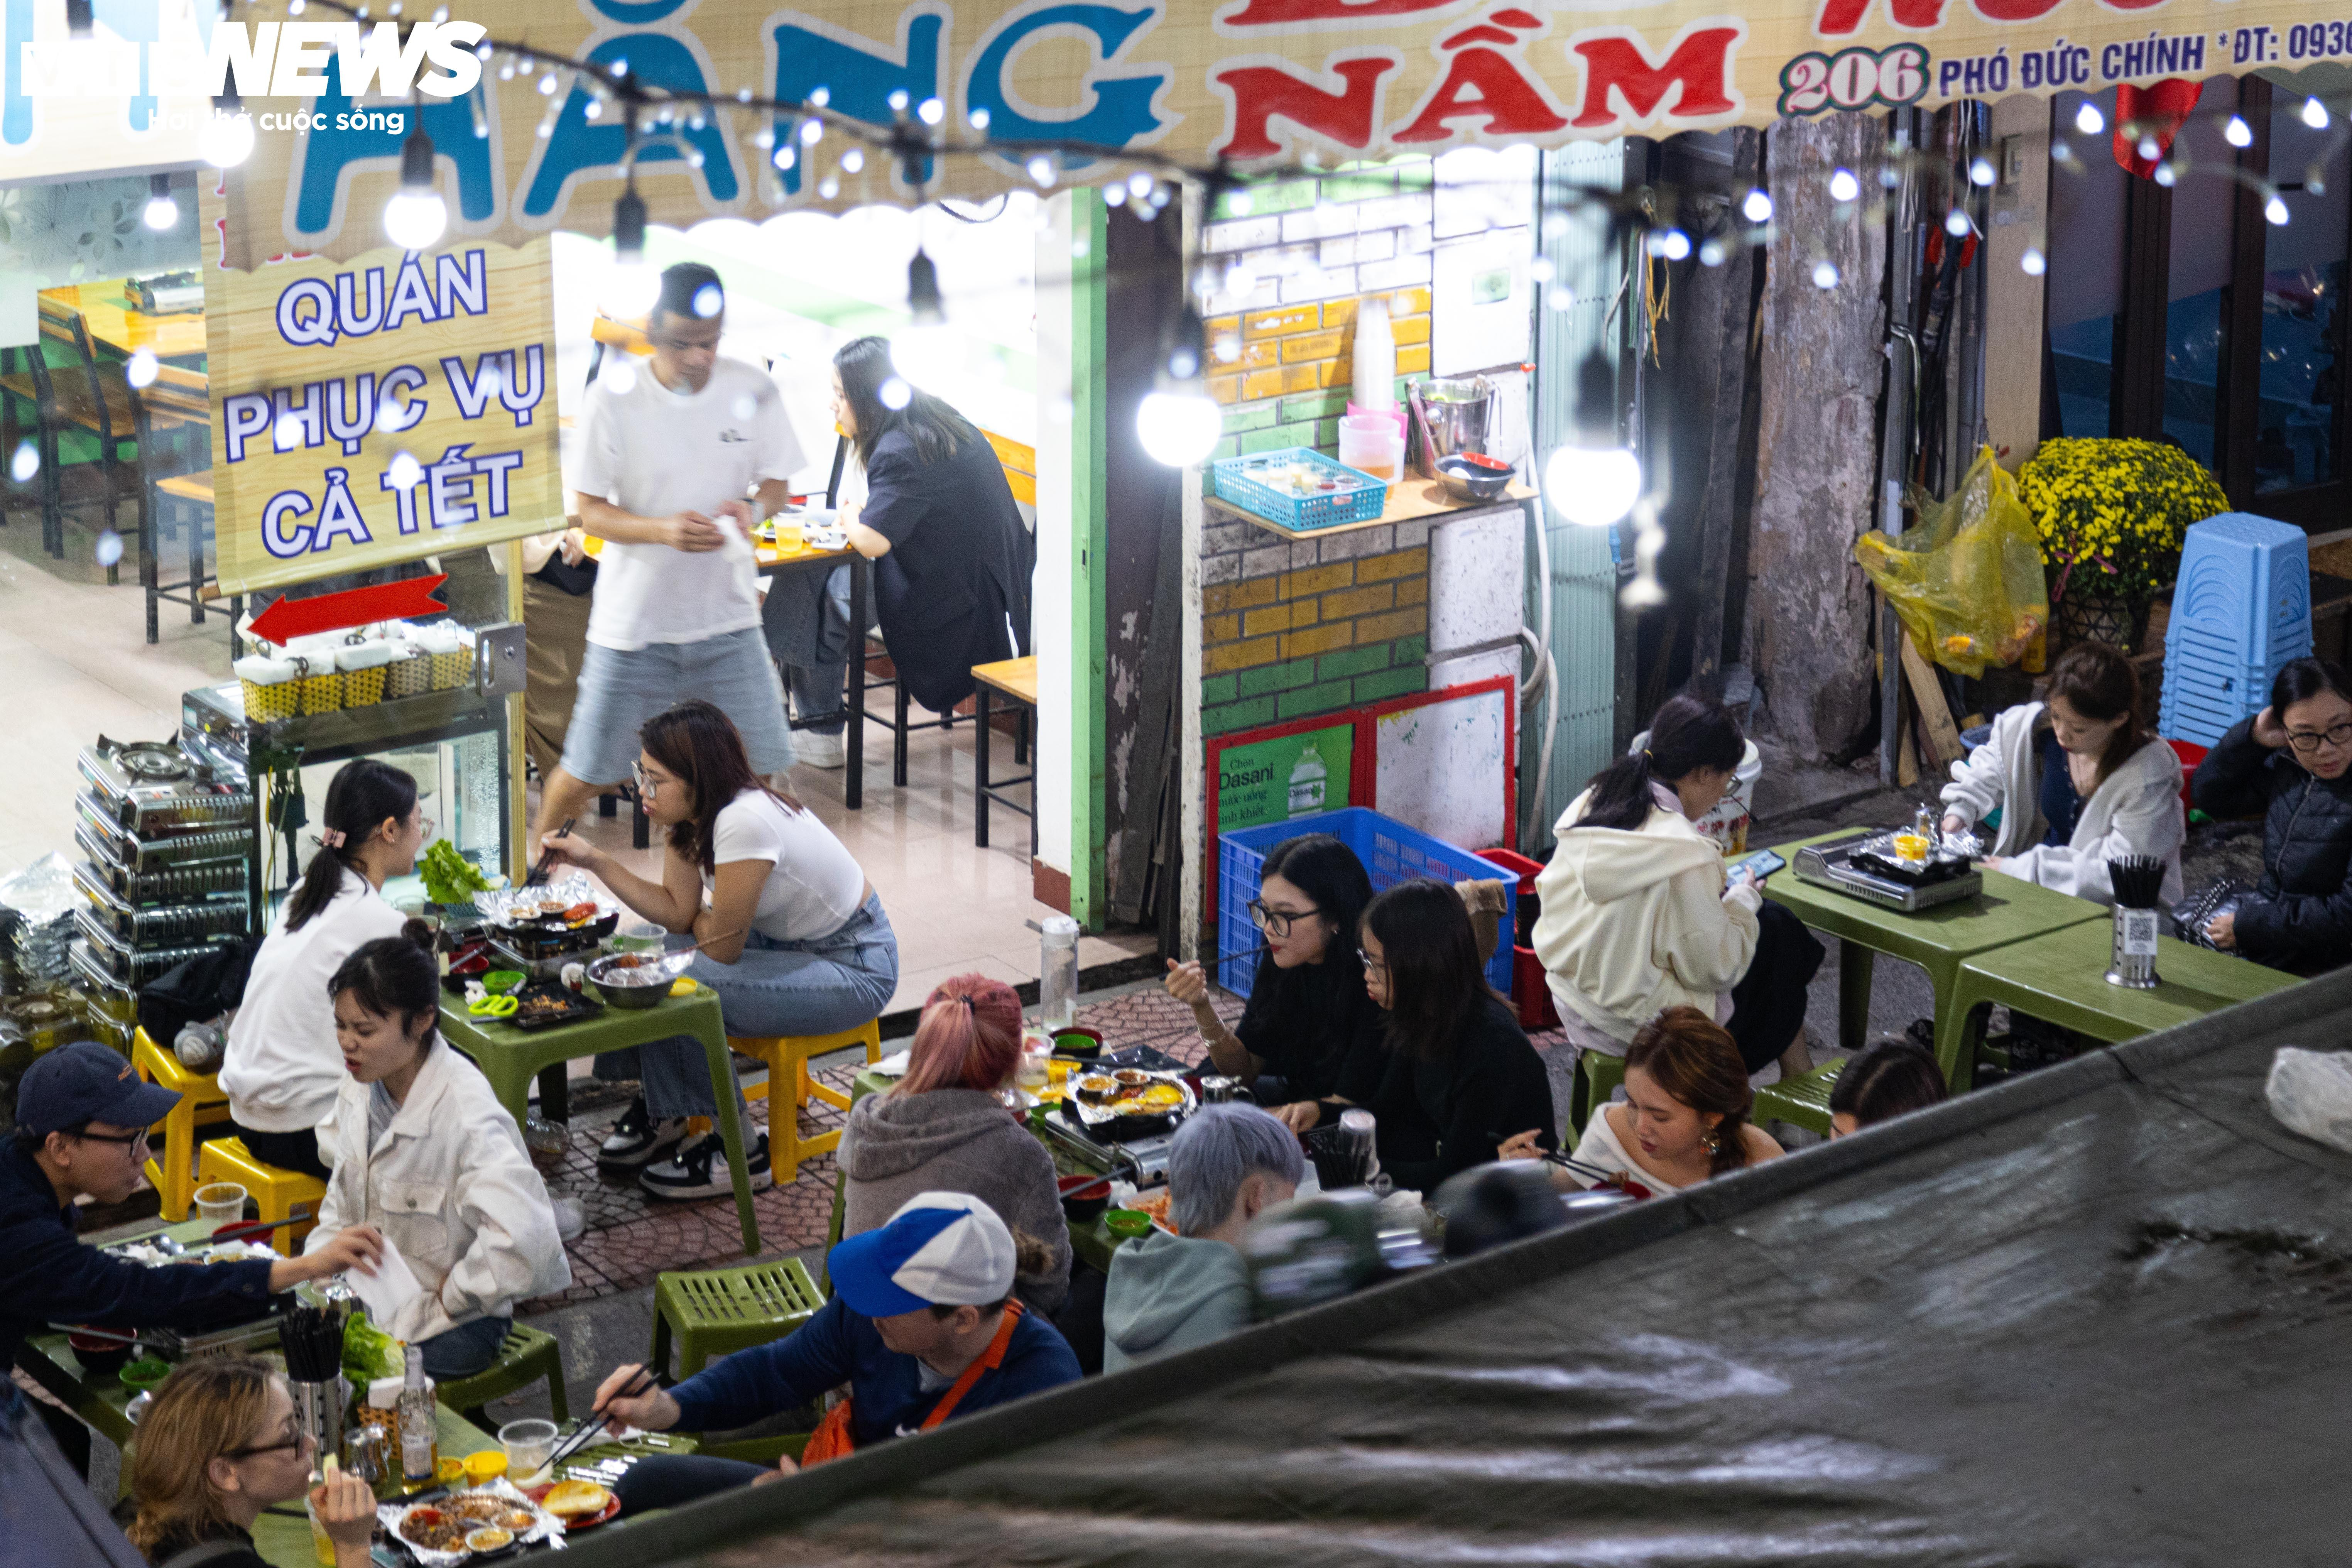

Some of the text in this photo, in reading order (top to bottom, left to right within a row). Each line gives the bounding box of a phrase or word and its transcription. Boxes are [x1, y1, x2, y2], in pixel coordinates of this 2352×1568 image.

[1215, 8, 1740, 156] NẤM
[1777, 42, 1930, 118] 206
[1940, 48, 2009, 96] PHÓ
[2021, 40, 2090, 88] ĐỨC
[2102, 32, 2205, 79] CHÍNH
[276, 248, 488, 347] QUÁN
[223, 344, 544, 463] PHỤC VỤ
[262, 443, 523, 558] CẢ TẾT
[1219, 762, 1273, 790] Dasani
